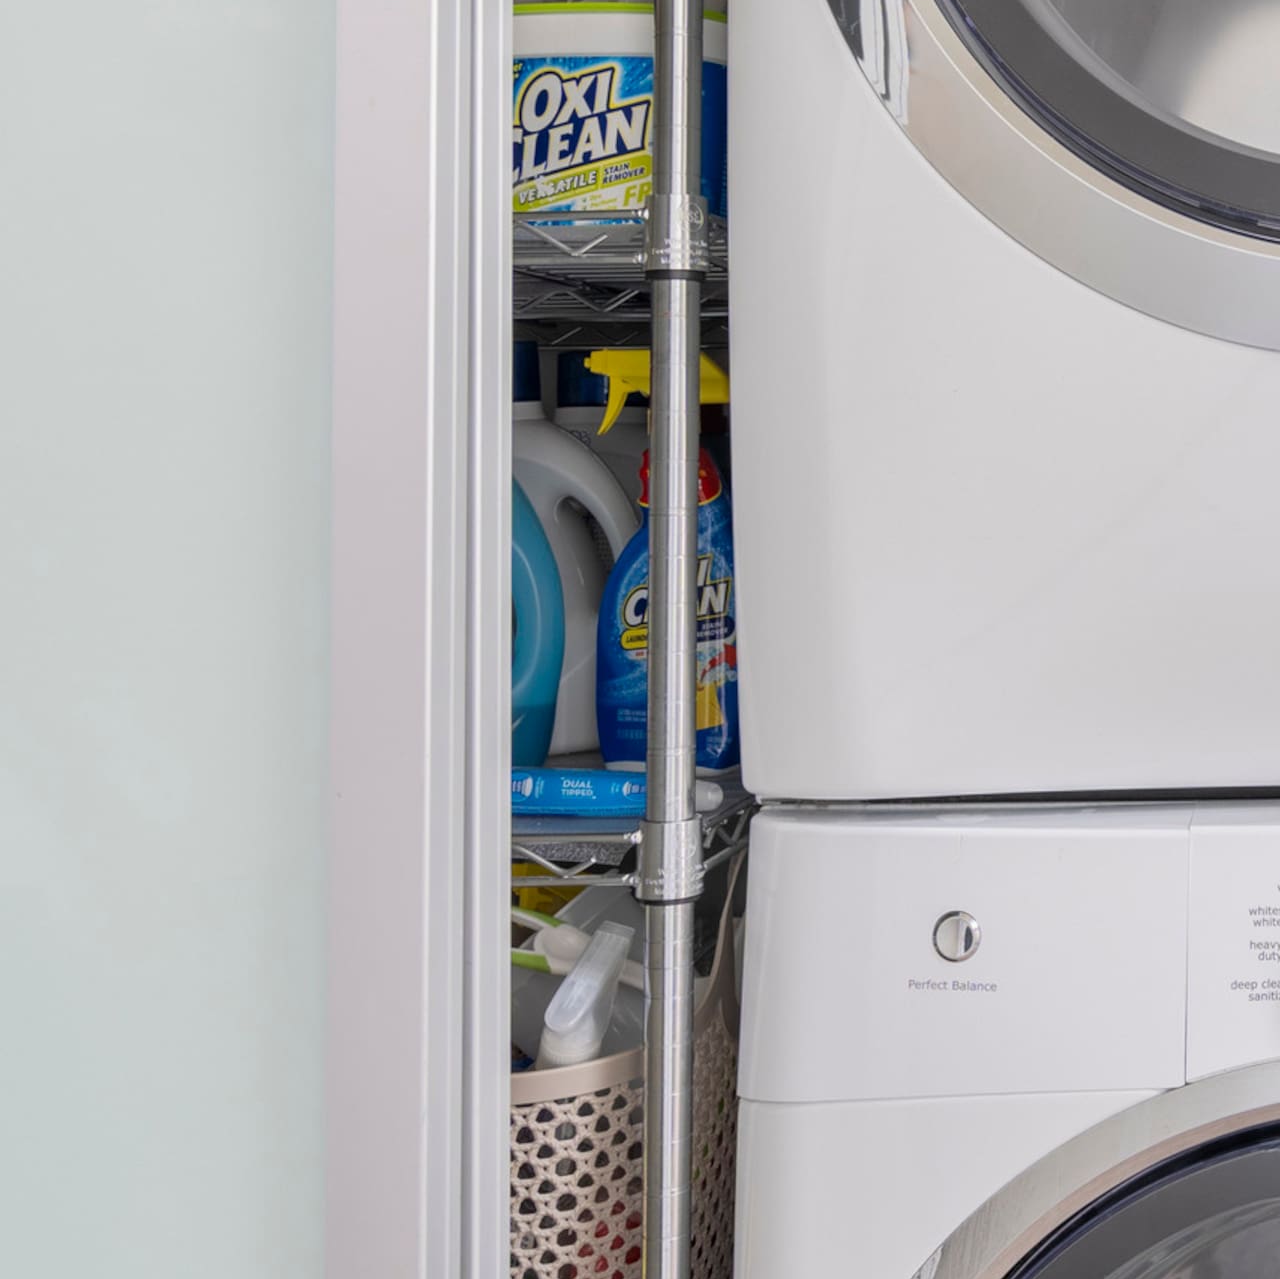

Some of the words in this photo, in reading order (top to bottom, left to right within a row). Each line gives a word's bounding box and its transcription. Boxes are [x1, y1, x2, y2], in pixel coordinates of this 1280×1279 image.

[521, 68, 615, 133] OXI
[604, 162, 631, 174] STAIN
[602, 167, 646, 185] REMOVER
[562, 780, 592, 788] DUAL
[561, 788, 594, 796] TIPPED
[908, 979, 948, 990] Perfect
[952, 980, 998, 992] Balance
[1230, 980, 1258, 992] deep
